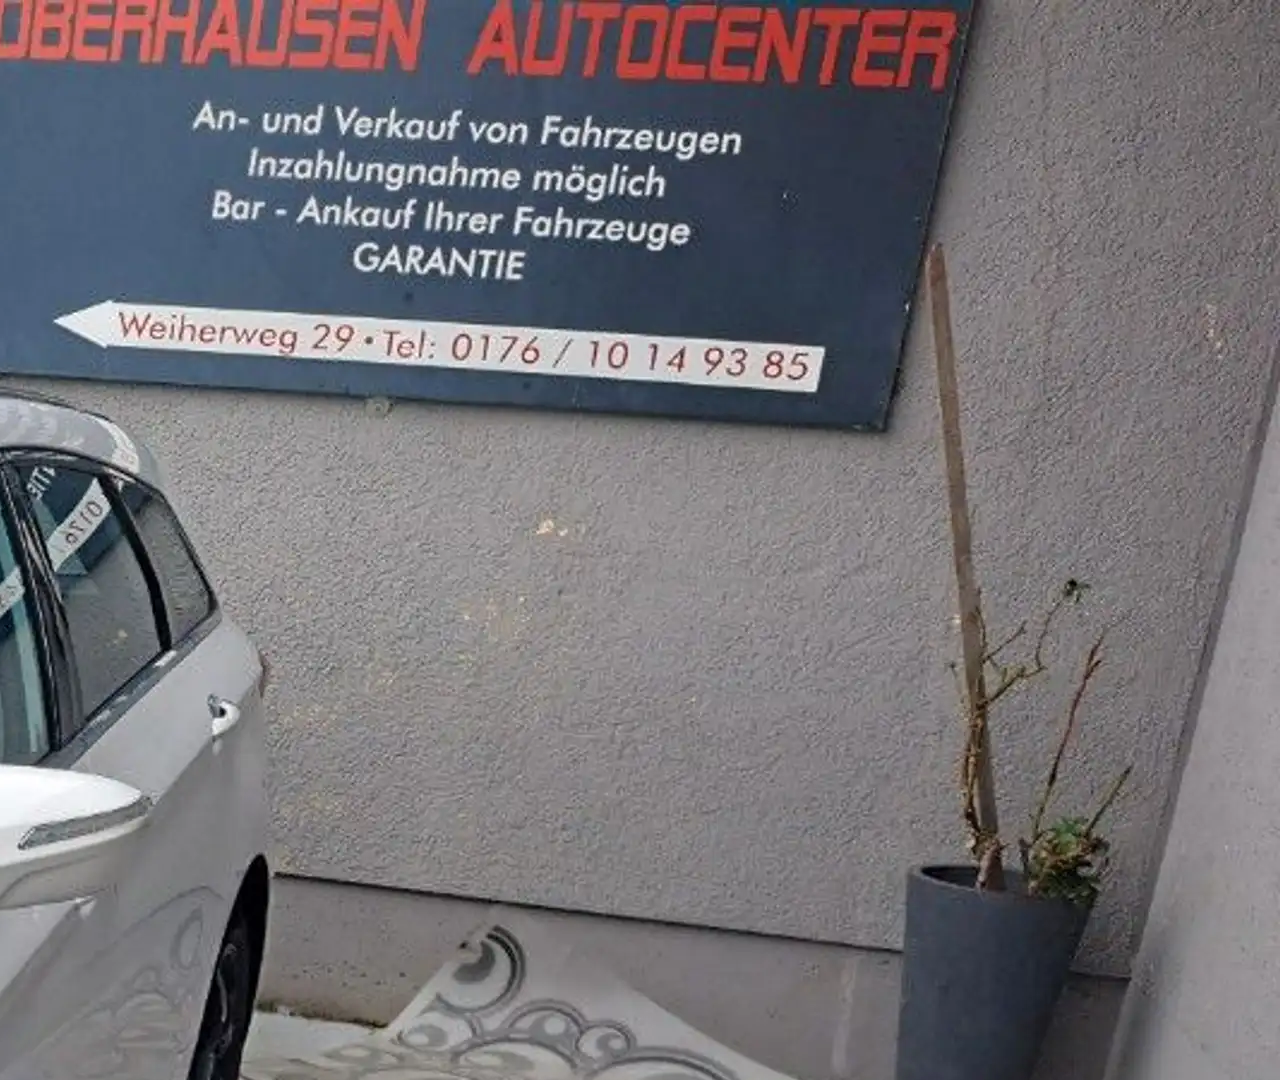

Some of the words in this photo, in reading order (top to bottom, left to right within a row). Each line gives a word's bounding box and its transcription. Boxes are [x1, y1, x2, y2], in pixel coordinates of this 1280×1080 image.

[467, 0, 957, 90] AUTOCENTER
[192, 100, 250, 131] An-
[262, 104, 324, 135] und
[335, 105, 463, 141] Verkauf
[469, 120, 529, 145] von
[540, 115, 742, 160] Fahrzeugen
[247, 147, 522, 192] Inzahlungnahme
[532, 163, 667, 202] möglich
[211, 189, 265, 220] Bar
[295, 195, 418, 230] Ankauf
[424, 200, 503, 234] Ihrer
[512, 206, 691, 252] Fahrzeuge
[353, 241, 527, 280] GARANTIE
[118, 311, 298, 354] Weiherweg
[312, 323, 355, 351] 29
[382, 329, 437, 360] Tel:
[450, 333, 541, 364] 0176
[589, 340, 630, 369] 10
[647, 343, 687, 372] 14
[703, 347, 748, 377] 93
[762, 350, 810, 380] 85
